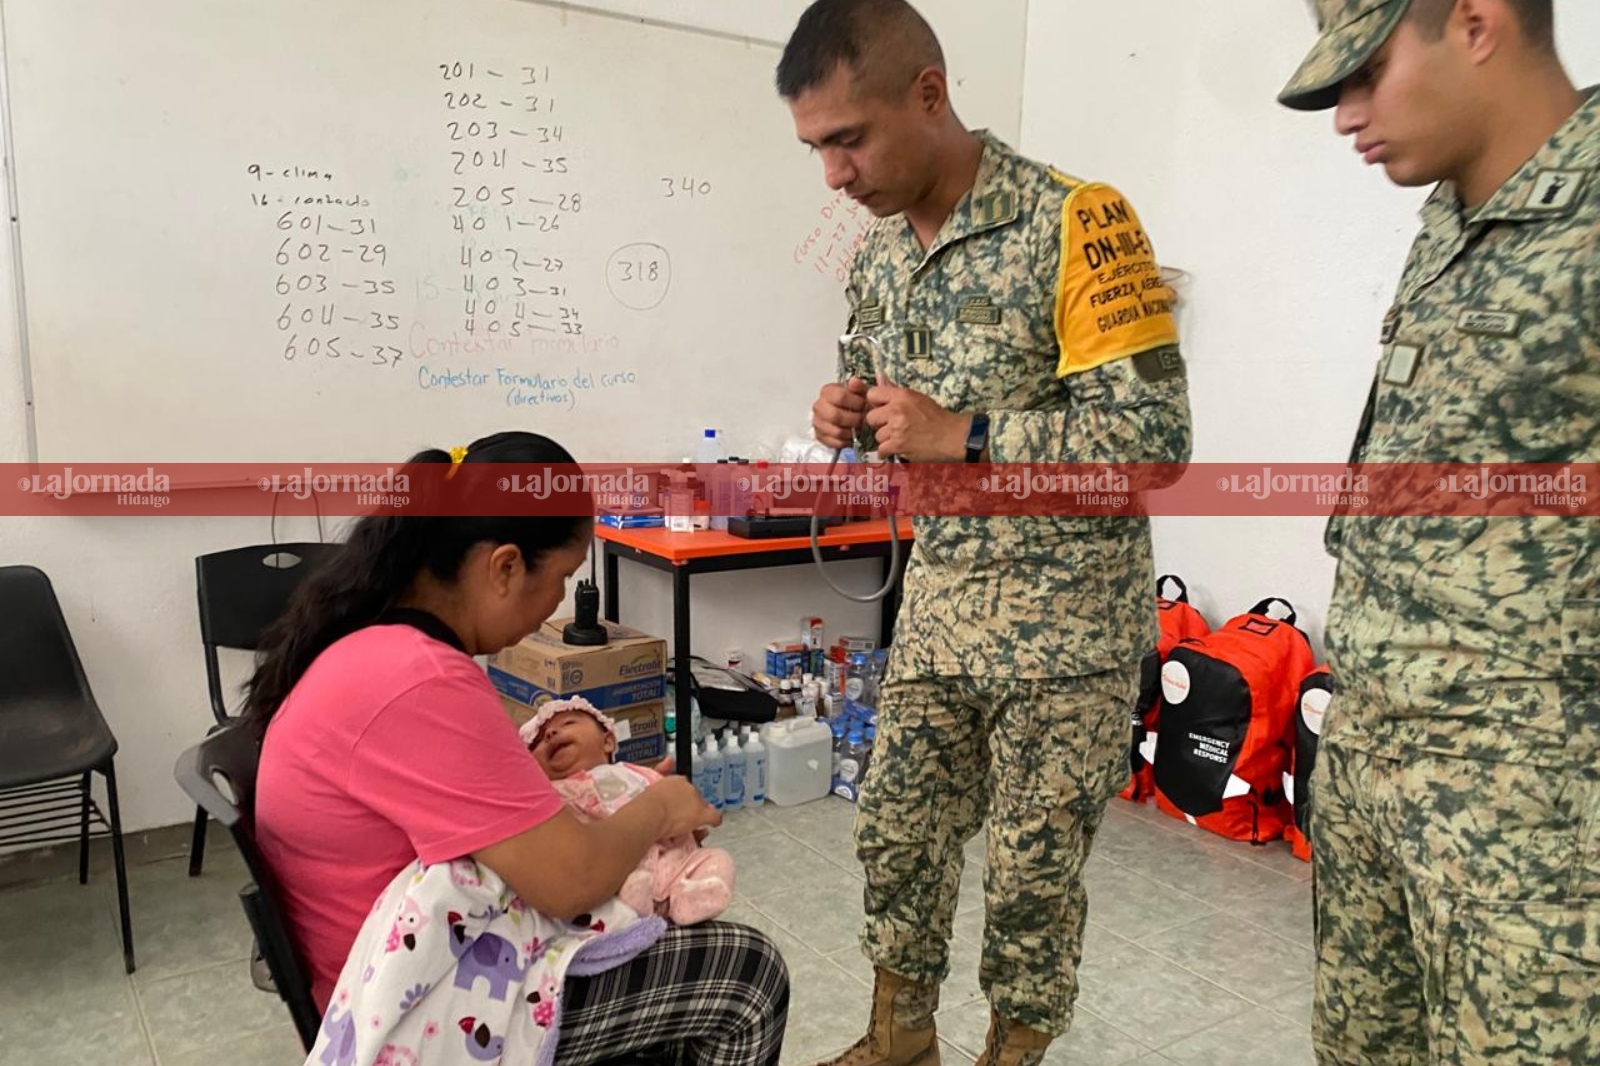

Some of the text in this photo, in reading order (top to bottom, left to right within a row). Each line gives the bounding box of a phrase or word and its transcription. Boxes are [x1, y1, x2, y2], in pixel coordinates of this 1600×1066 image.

[660, 176, 712, 199] 340
[1076, 199, 1131, 234] PLAN
[616, 260, 660, 282] 318
[1089, 282, 1136, 309] FUERZA
[1096, 304, 1141, 334] GUARDIA
[418, 365, 490, 390] Contestar
[572, 367, 595, 389] del
[1188, 732, 1231, 750] EMERGENCY
[1198, 742, 1230, 757] MEDICAL
[1193, 748, 1229, 764] RESPONSE
